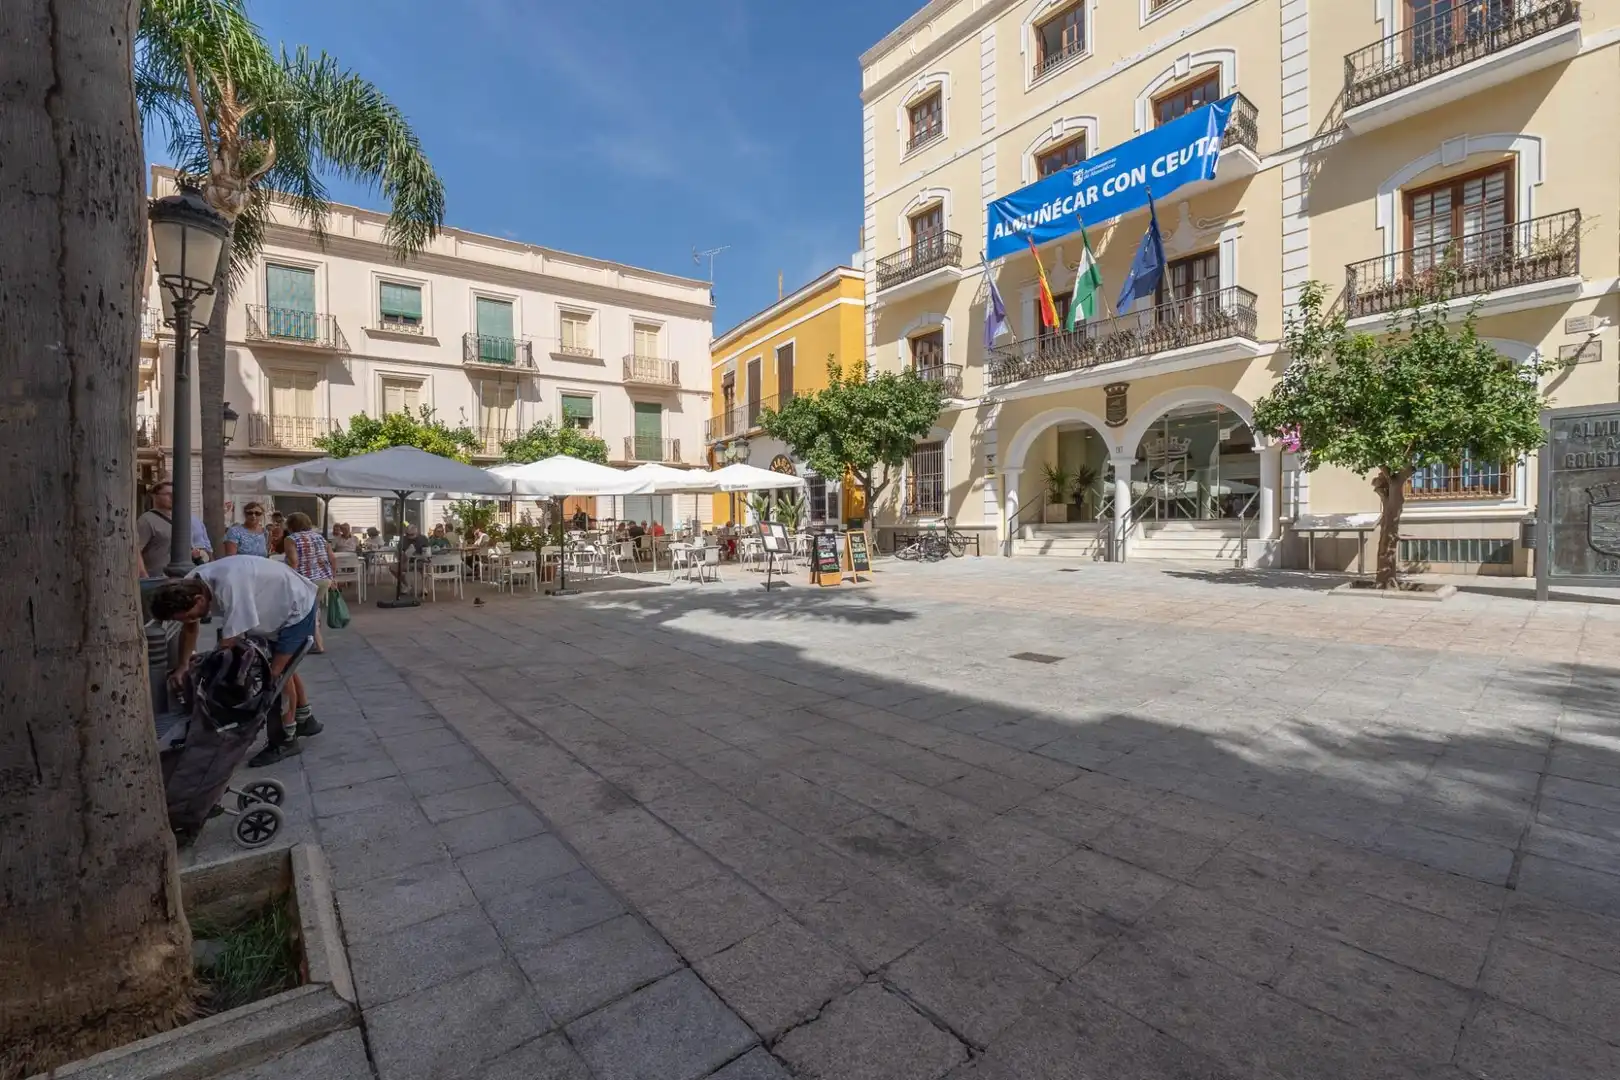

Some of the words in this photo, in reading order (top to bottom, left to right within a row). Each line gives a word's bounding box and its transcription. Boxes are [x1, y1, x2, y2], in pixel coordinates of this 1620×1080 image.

[993, 185, 1099, 241] ALMUÑÉCAR
[1102, 164, 1146, 197] CON
[1151, 136, 1220, 178] CEUTA
